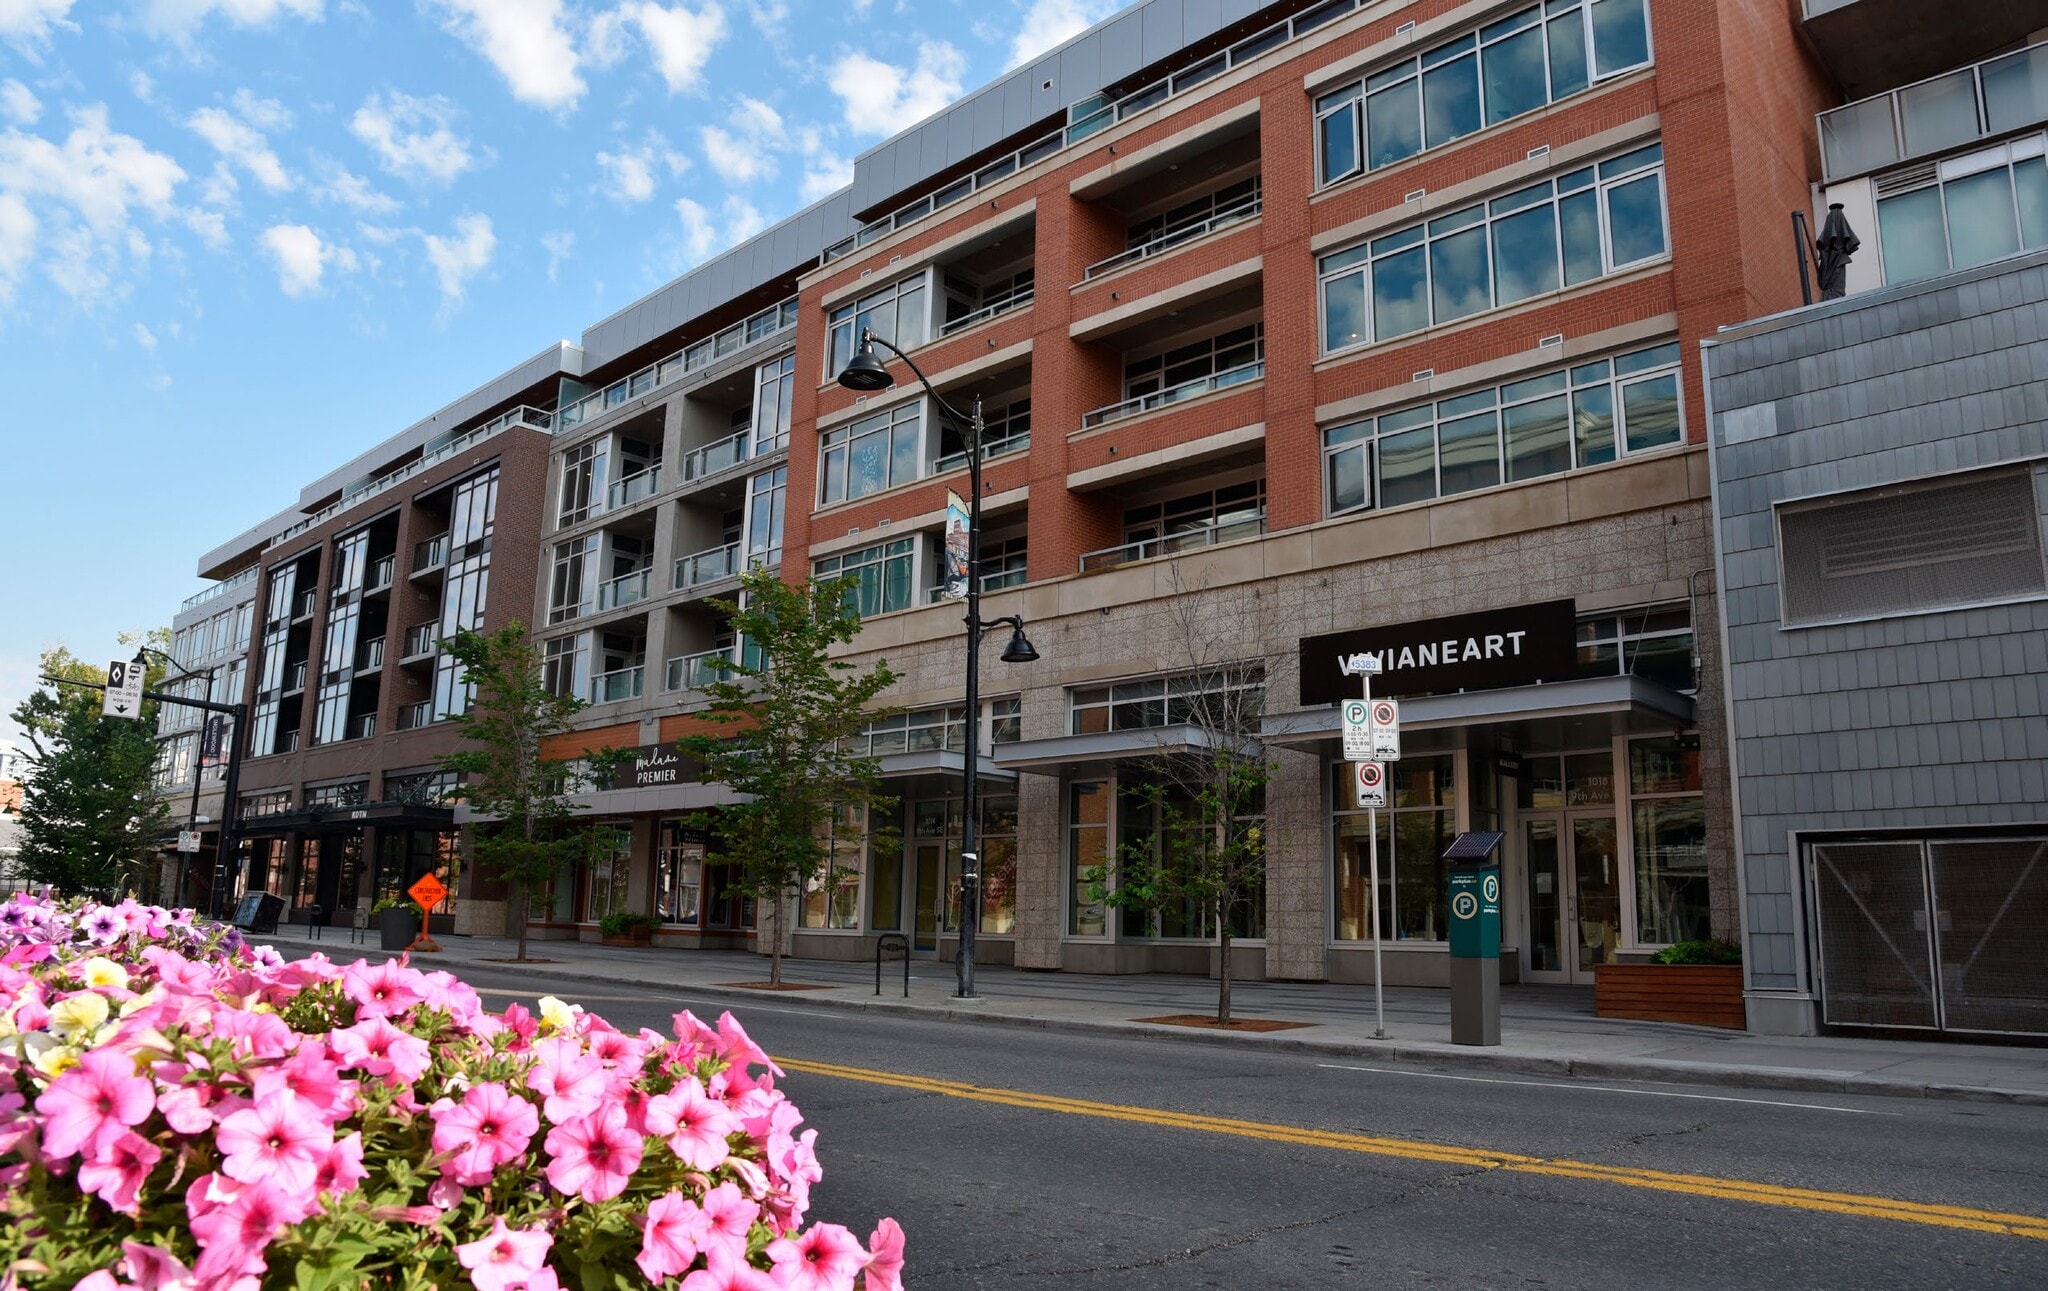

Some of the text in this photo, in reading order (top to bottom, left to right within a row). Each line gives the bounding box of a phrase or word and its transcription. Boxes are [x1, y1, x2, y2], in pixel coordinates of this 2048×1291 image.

[1337, 631, 1526, 676] VIANEART
[1355, 660, 1376, 669] 5383
[637, 769, 676, 784] PREMIER
[1571, 791, 1609, 801] 9th Ave
